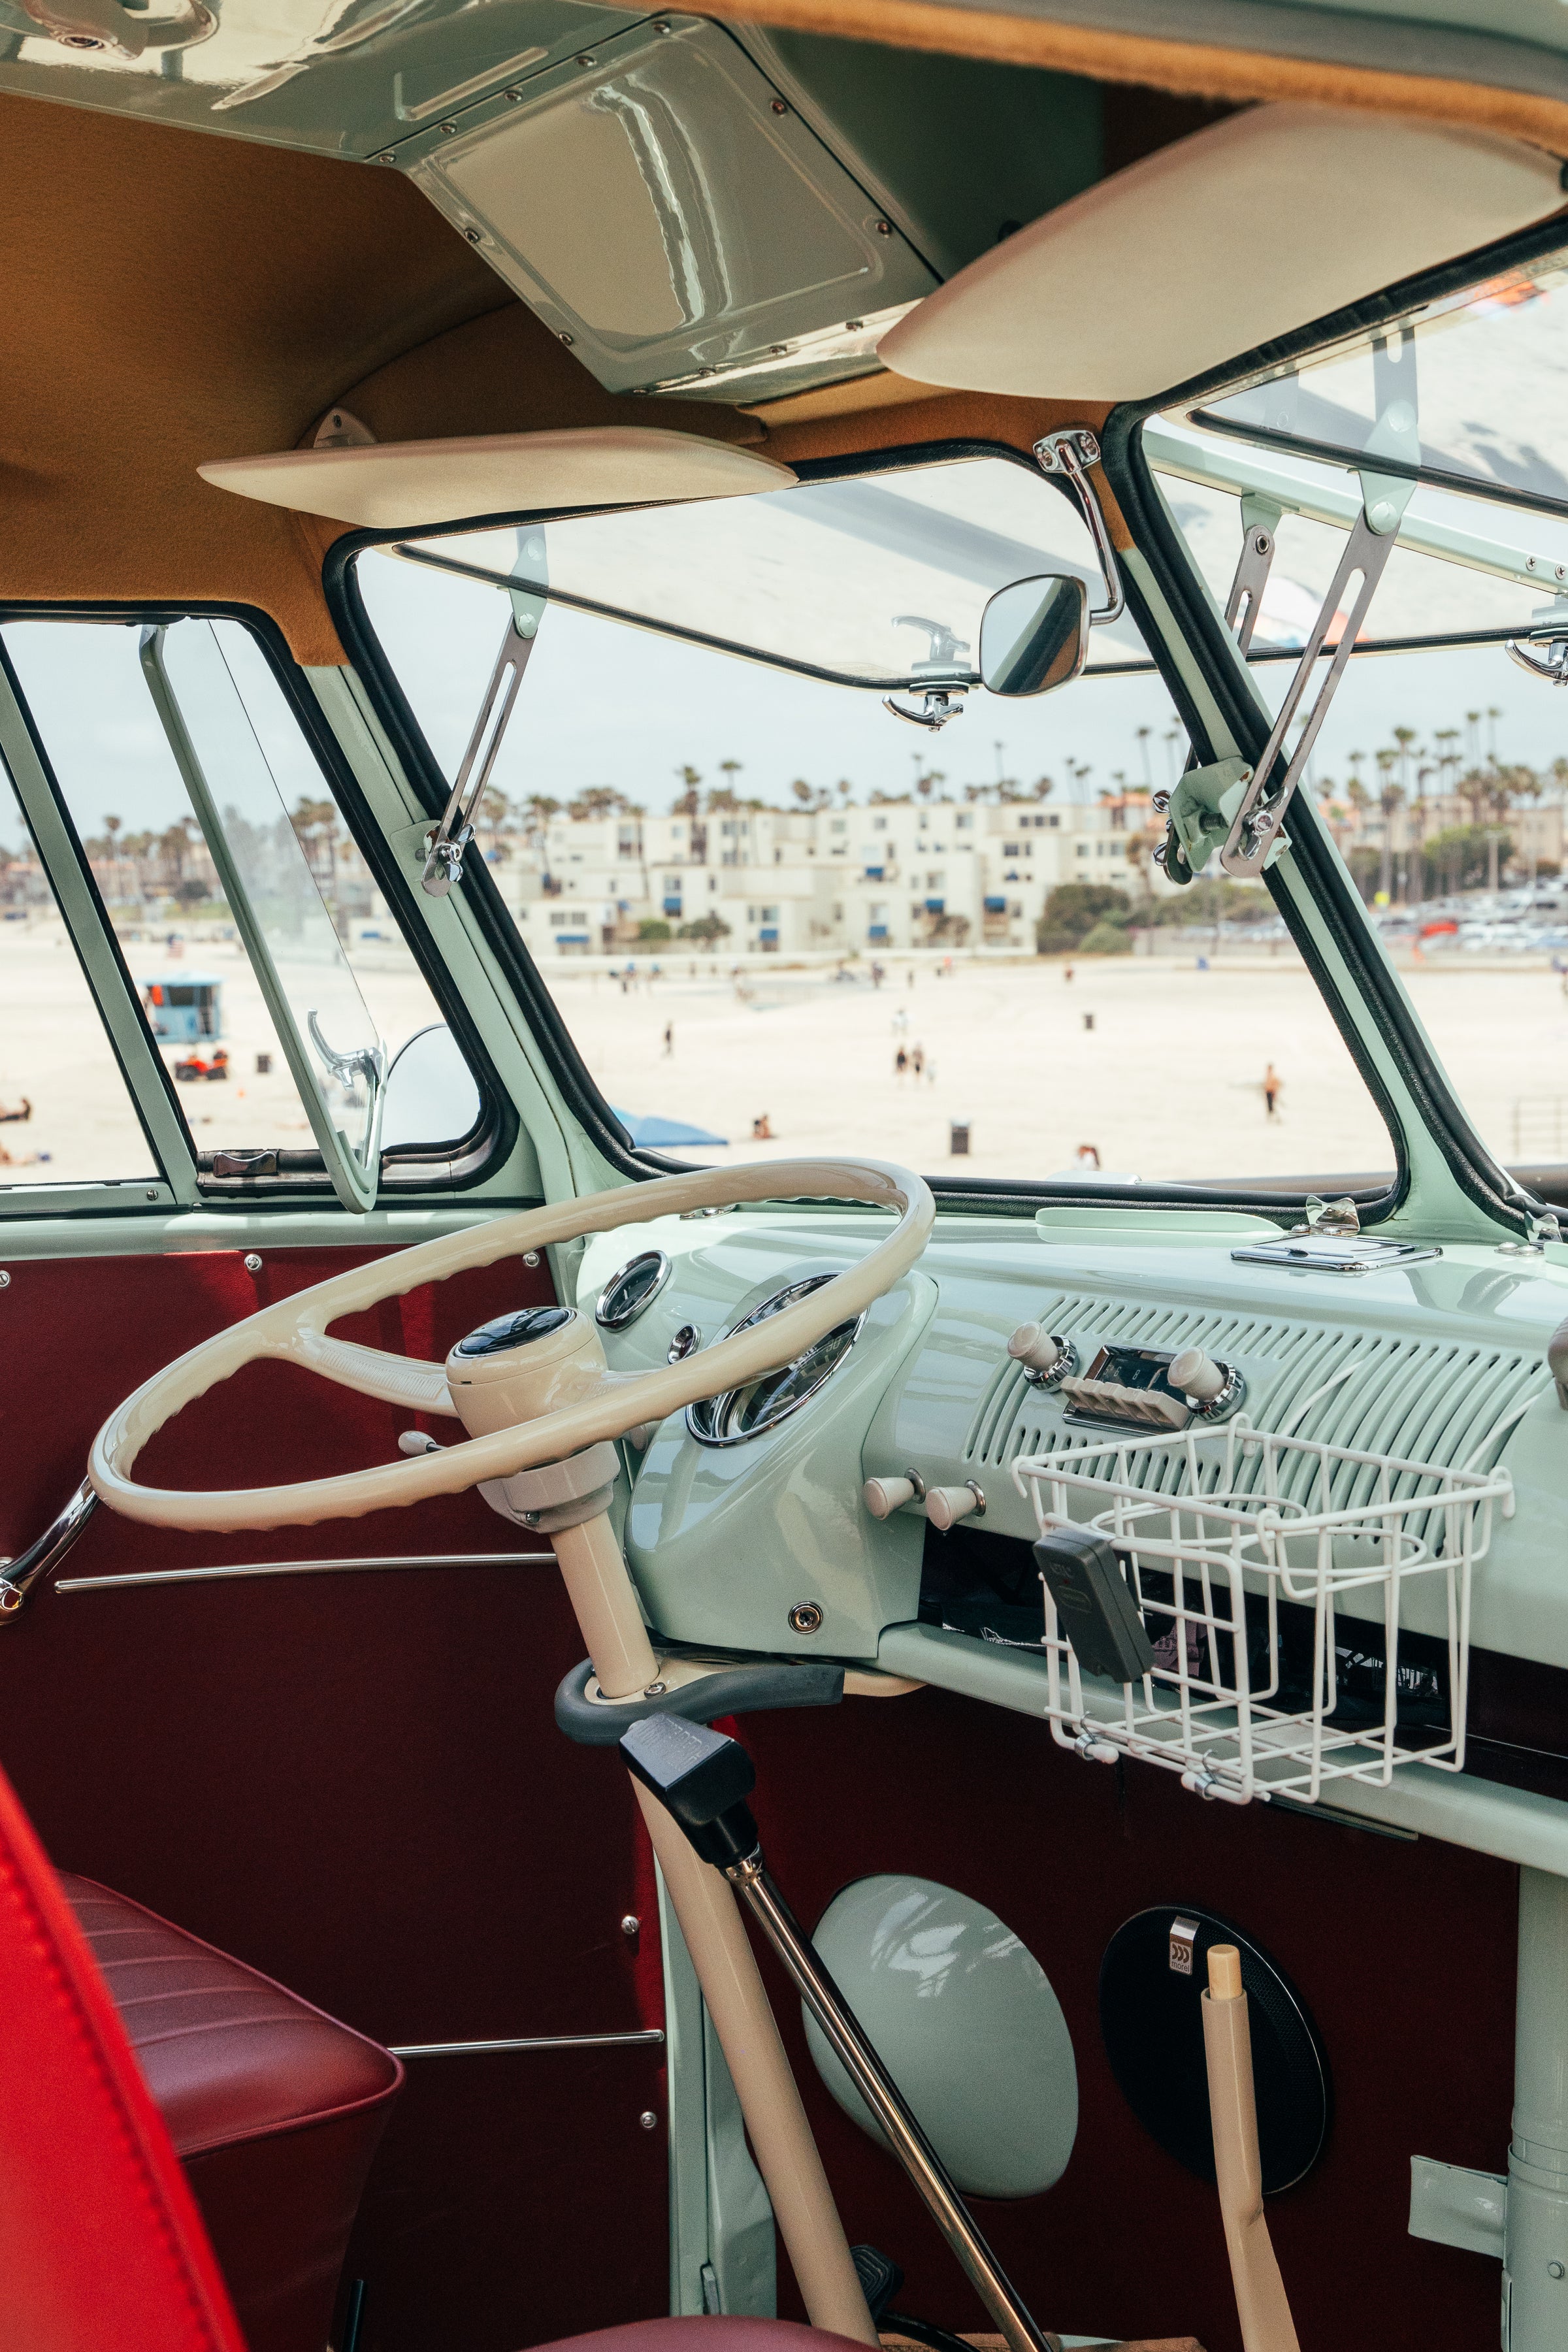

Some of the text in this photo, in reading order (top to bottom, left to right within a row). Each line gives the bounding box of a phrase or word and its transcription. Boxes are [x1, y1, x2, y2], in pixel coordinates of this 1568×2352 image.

[1113, 1367, 1121, 1377] 6
[1132, 1369, 1141, 1380] 8
[1171, 1961, 1190, 1972] morel
